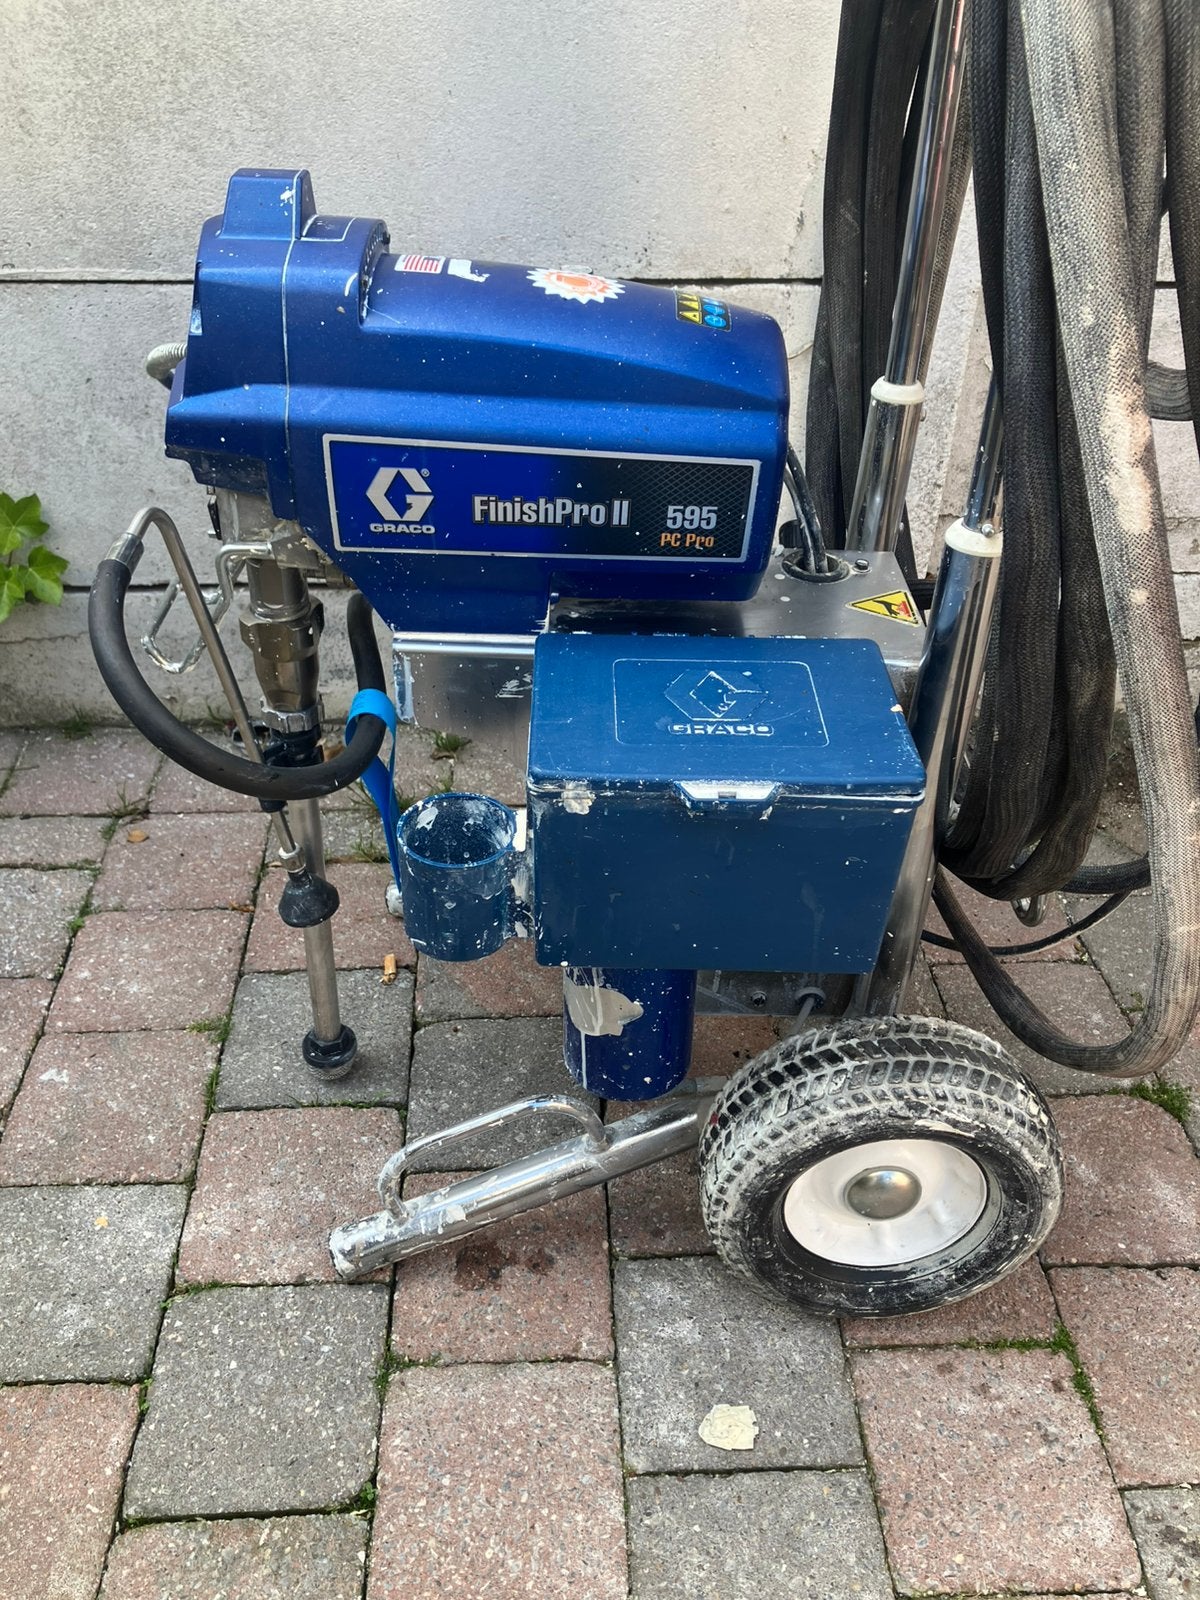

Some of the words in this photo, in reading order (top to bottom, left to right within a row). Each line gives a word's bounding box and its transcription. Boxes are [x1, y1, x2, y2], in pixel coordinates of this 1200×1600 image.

[473, 496, 606, 526] FinishPro
[611, 499, 630, 526] II
[666, 505, 719, 530] 595
[370, 523, 435, 534] GRACO
[660, 532, 682, 547] PC
[685, 533, 715, 548] Pro
[668, 722, 774, 737] GRACO
